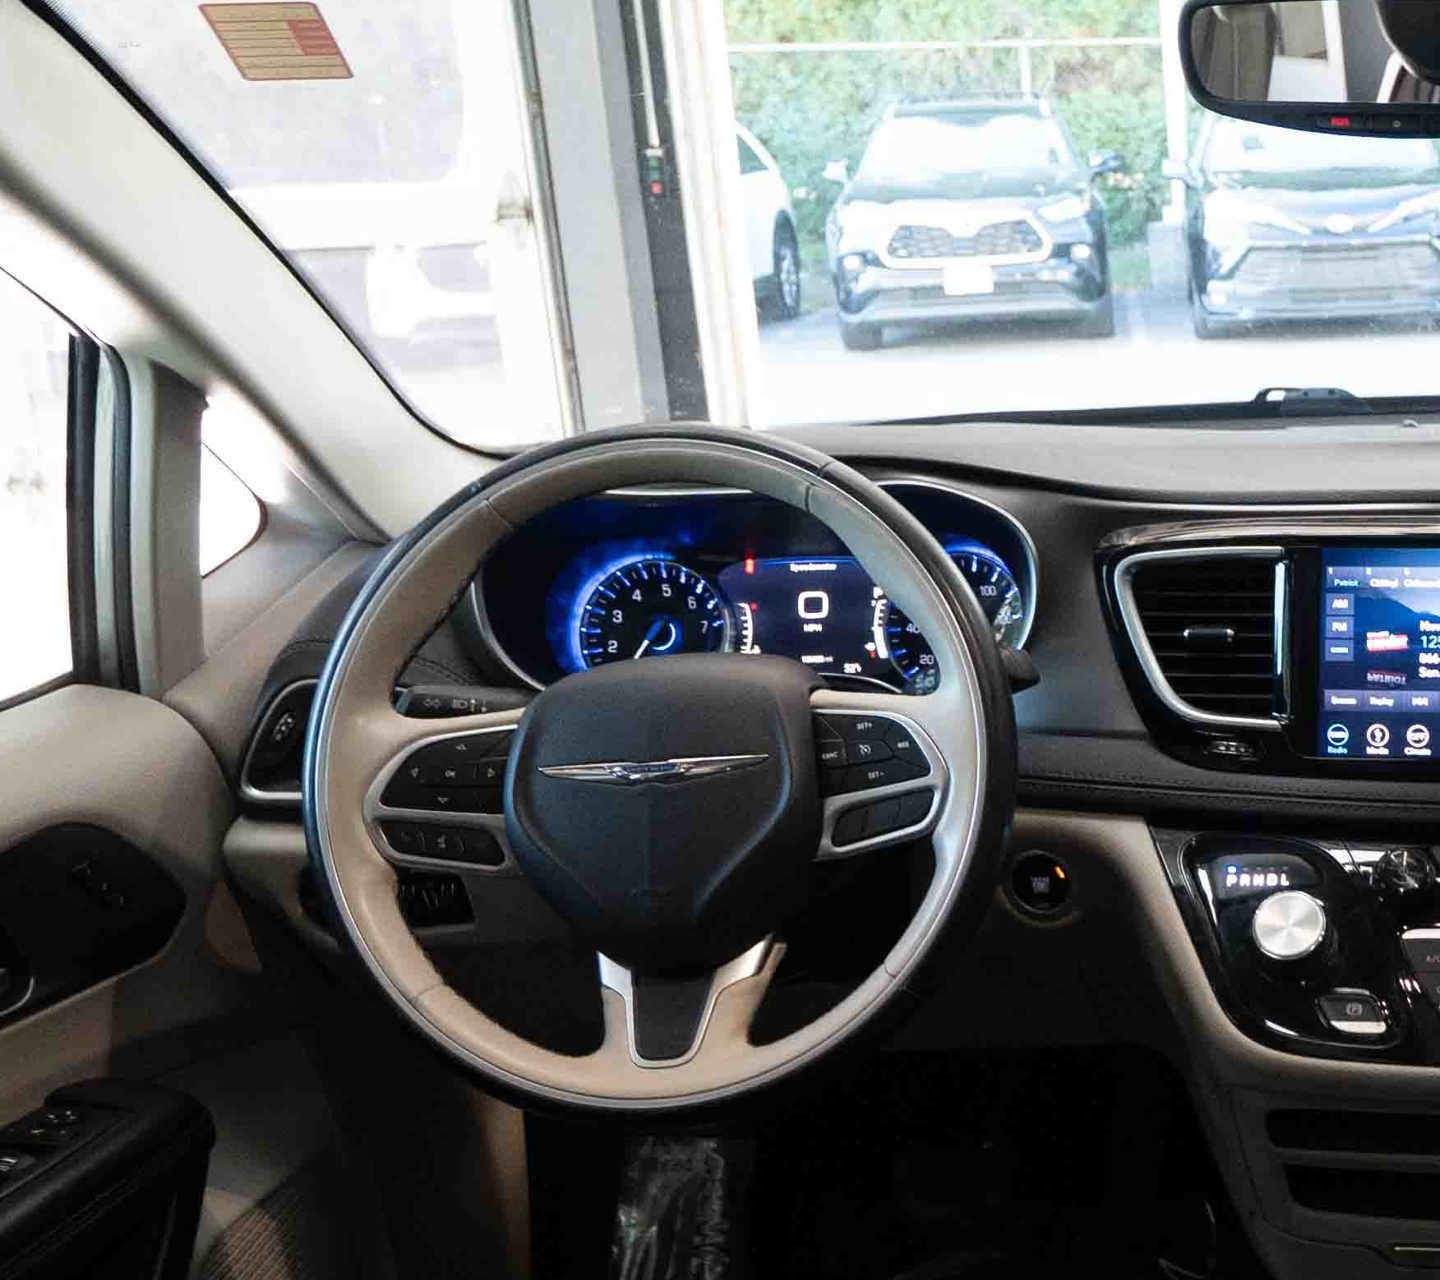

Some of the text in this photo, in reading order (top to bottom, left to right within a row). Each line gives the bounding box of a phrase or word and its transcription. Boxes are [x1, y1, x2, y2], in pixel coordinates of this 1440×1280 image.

[632, 589, 642, 602] 4
[661, 584, 672, 597] 5
[980, 586, 997, 597] 100
[688, 597, 697, 609] 6
[797, 591, 829, 619] 0
[612, 610, 623, 623] 3
[701, 621, 709, 634] 7
[607, 640, 618, 652] 2
[920, 655, 934, 665] 20
